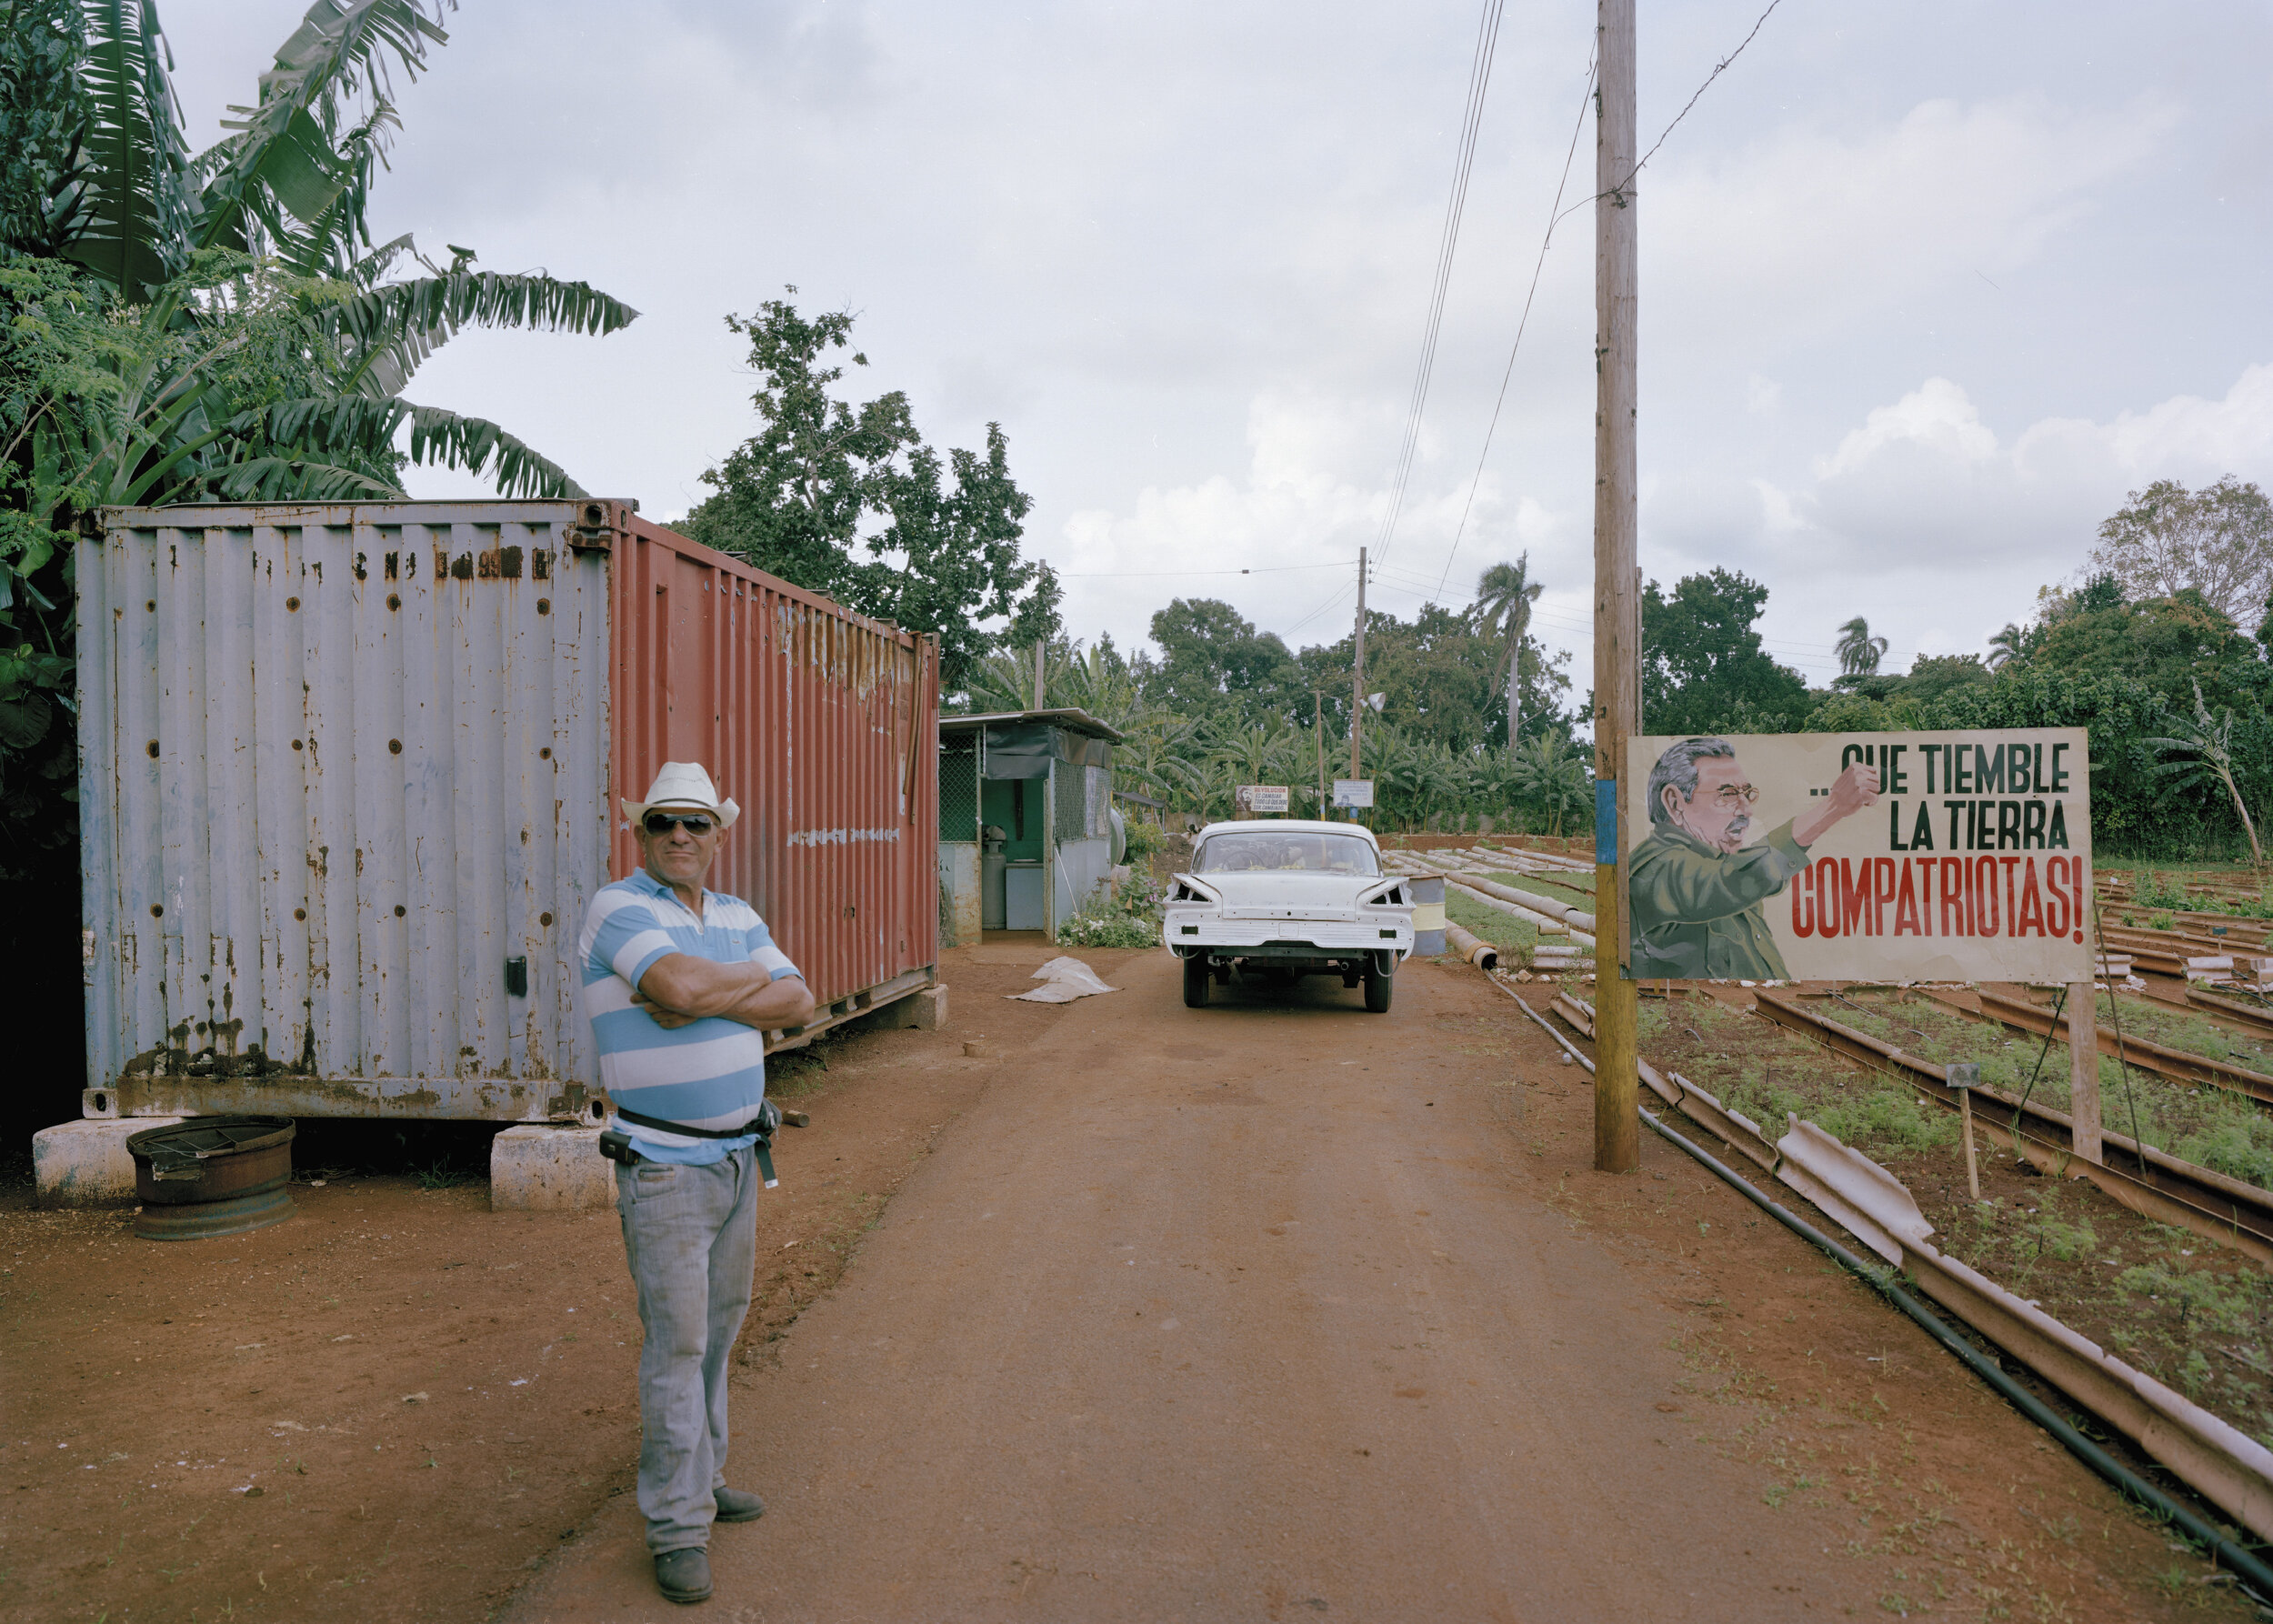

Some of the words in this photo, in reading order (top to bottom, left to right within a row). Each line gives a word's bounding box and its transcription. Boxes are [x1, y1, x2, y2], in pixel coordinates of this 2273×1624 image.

[1918, 743, 2069, 795] TIEMBLE
[1890, 800, 1934, 850] LA
[1944, 800, 2069, 850] TIERRA
[1792, 855, 2084, 945] COMPATRIOTAS!
